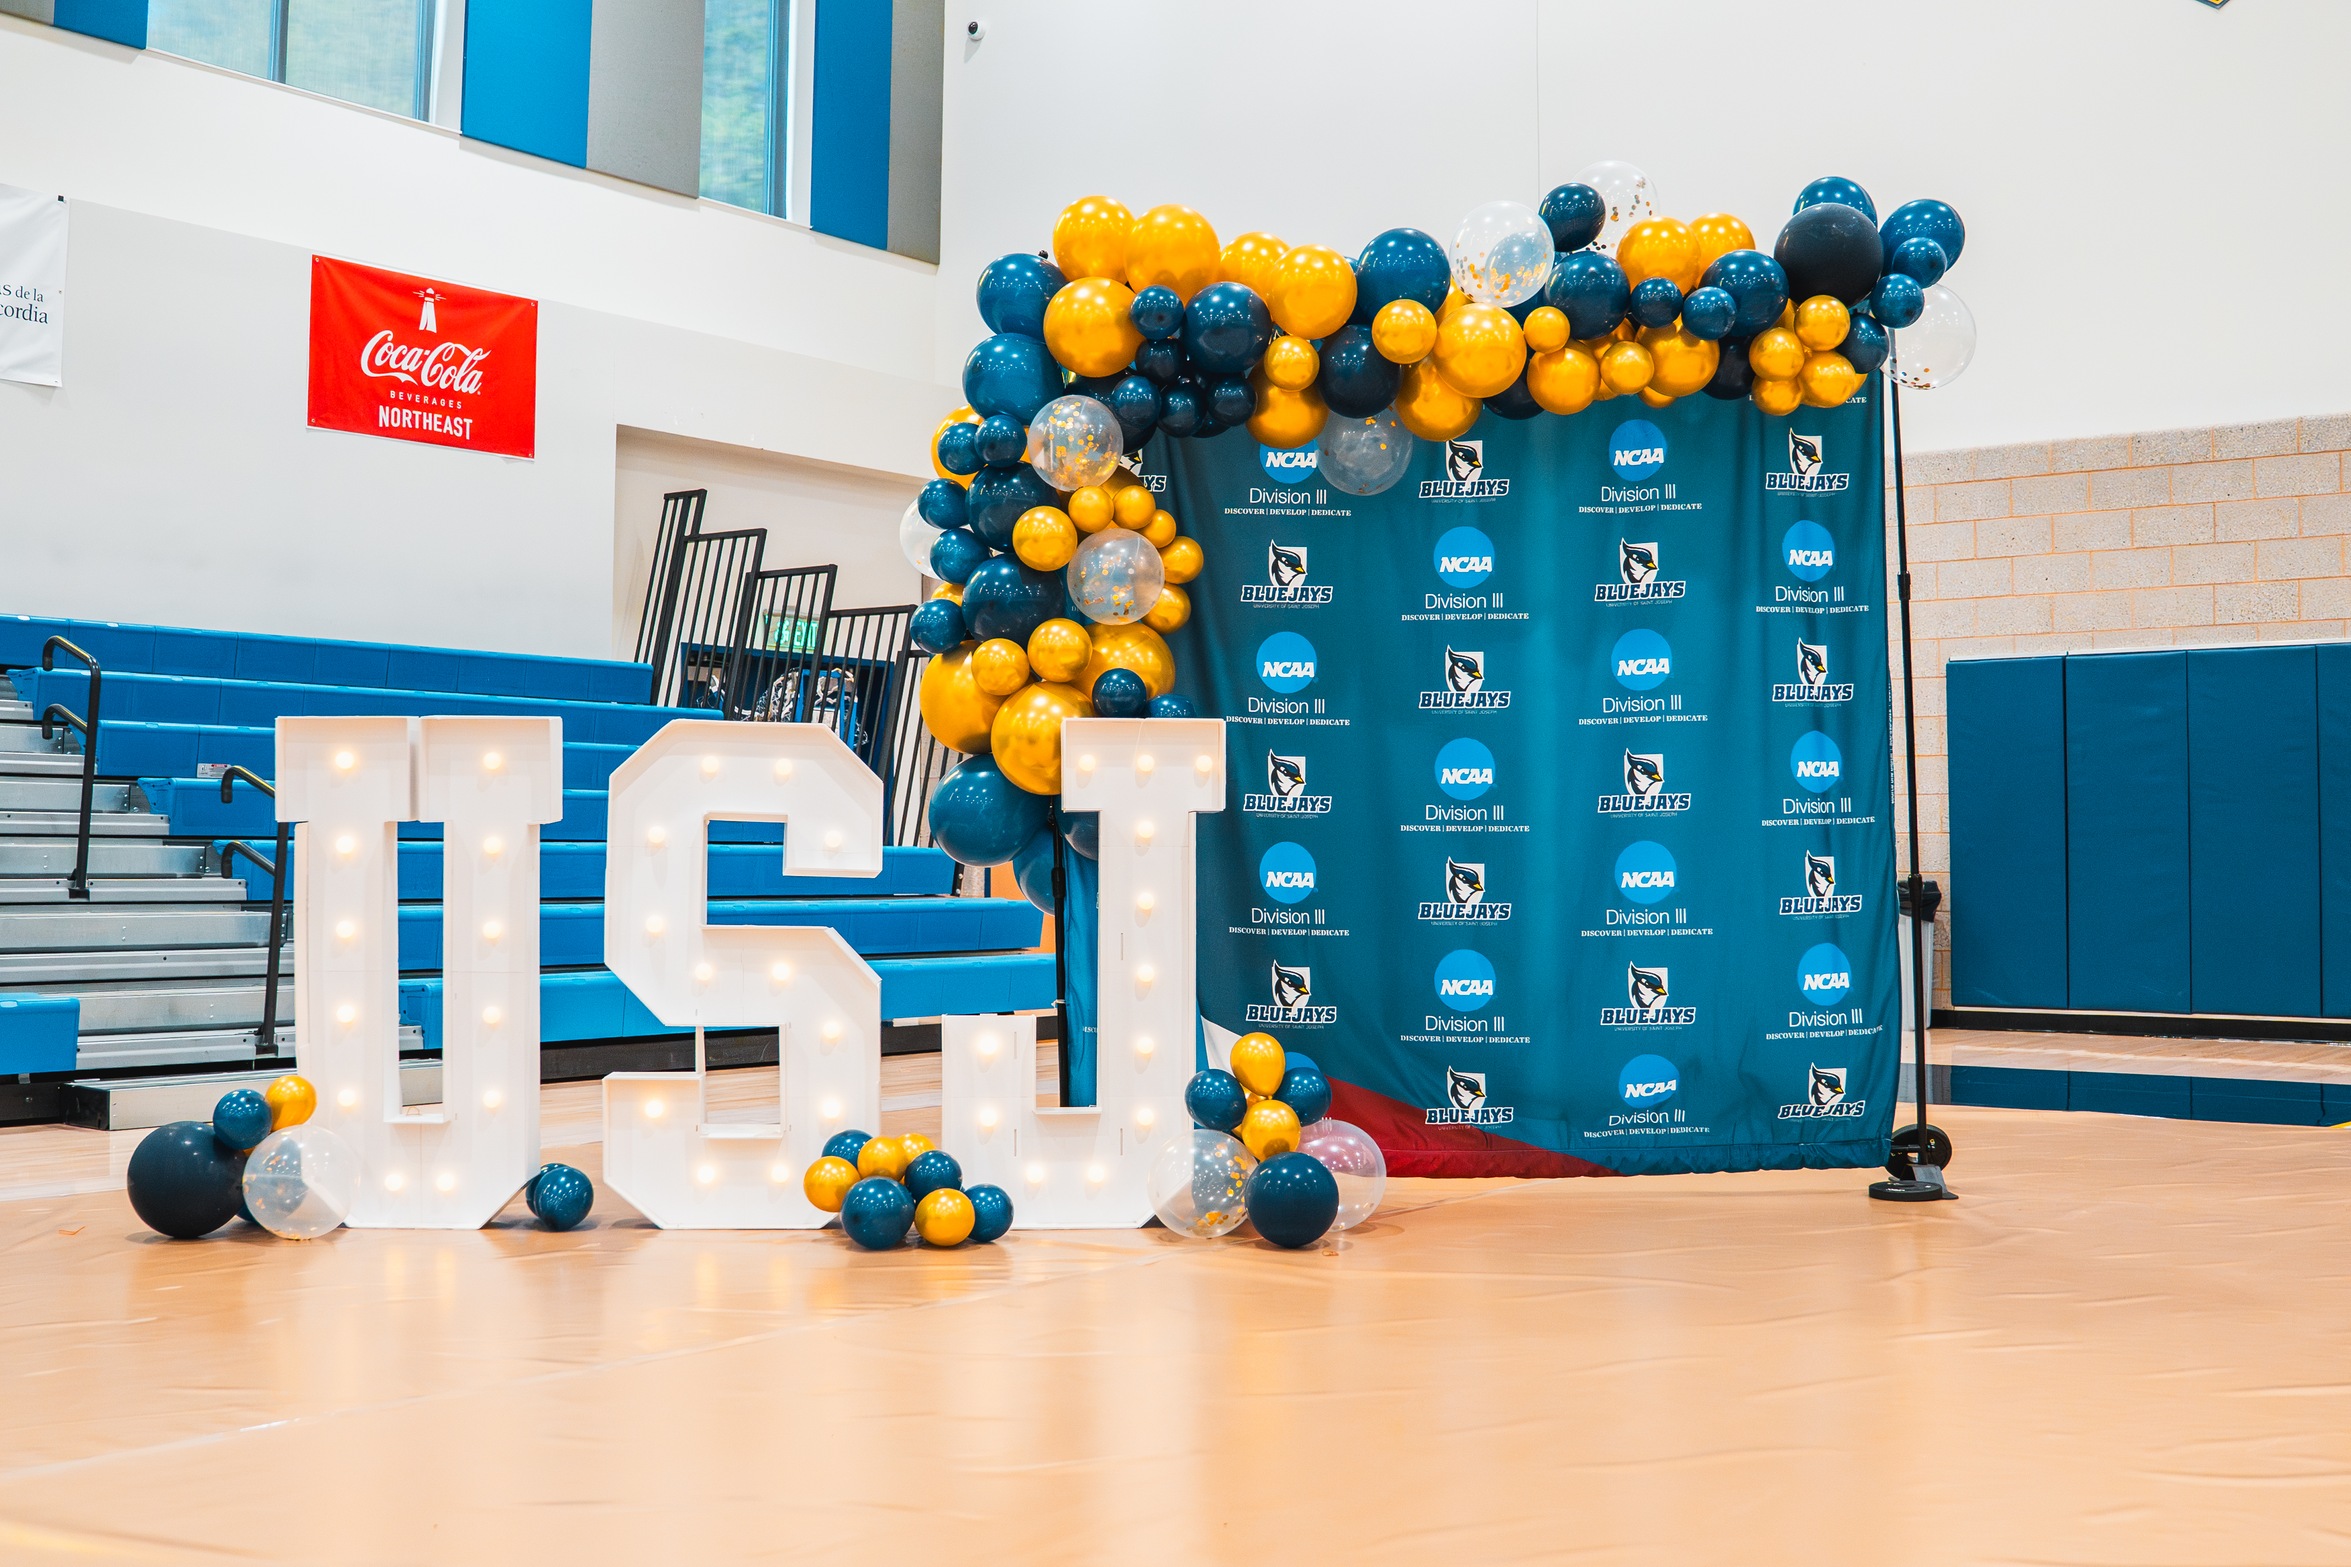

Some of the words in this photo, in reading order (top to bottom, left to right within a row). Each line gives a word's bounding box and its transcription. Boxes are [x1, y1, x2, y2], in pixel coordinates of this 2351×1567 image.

[15, 285, 31, 299] de
[33, 288, 44, 303] la
[360, 330, 491, 394] Coca-Cola
[390, 390, 462, 409] BEVERAGES
[379, 405, 473, 440] NORTHEAST
[1265, 451, 1318, 469] NCAA
[1613, 447, 1665, 467] NCAA
[1418, 479, 1510, 498] BLUEJAYS
[1765, 472, 1849, 491] BLUEJAYS
[1249, 487, 1311, 505] Division
[1315, 488, 1328, 505] III
[1601, 485, 1660, 503] Division
[1664, 483, 1676, 500] III
[1224, 507, 1266, 516] DISCOVER
[1269, 508, 1307, 516] DEVELOP
[1311, 509, 1352, 517] DEDICATE
[1578, 506, 1615, 514] DISCOVER
[1618, 505, 1657, 514] DEVELOP
[1660, 502, 1703, 511] DEDICATE
[1439, 556, 1493, 573] NCAA
[1788, 549, 1833, 567] NCAA
[1240, 585, 1333, 603] BLUEJAYS
[1594, 580, 1686, 601] BLUEJAYS
[1775, 585, 1829, 603] Division
[1833, 585, 1845, 602] III
[1425, 593, 1487, 610] Division
[1492, 592, 1504, 609] III
[1755, 605, 1791, 613] DISCOVER
[1795, 606, 1825, 614] DEVELOP
[1829, 605, 1870, 614] DEDICATE
[1401, 613, 1441, 621] DISCOVER
[1444, 613, 1483, 621] DEVELOP
[1487, 612, 1530, 620] DEDICATE
[1262, 661, 1315, 678] NCAA
[1616, 657, 1670, 677] NCAA
[1418, 691, 1511, 709] BLUEJAYS
[1772, 684, 1854, 702] BLUEJAYS
[1248, 696, 1309, 714] Division
[1314, 698, 1325, 714] III
[1602, 695, 1665, 714] Division
[1670, 694, 1682, 711] III
[1226, 716, 1263, 725] DISCOVER
[1267, 717, 1305, 726] DEVELOP
[1309, 718, 1351, 726] DEDICATE
[1578, 717, 1619, 726] DISCOVER
[1623, 715, 1662, 724] DEVELOP
[1665, 714, 1708, 722] DEDICATE
[1440, 767, 1494, 785] NCAA
[1796, 760, 1840, 778] NCAA
[1243, 794, 1332, 813] BLUEJAYS
[1597, 792, 1691, 813] BLUEJAYS
[1782, 797, 1835, 815] Division
[1840, 797, 1852, 813] III
[1425, 804, 1488, 821] Division
[1493, 804, 1504, 821] III
[1761, 818, 1800, 827] DISCOVER
[1803, 818, 1832, 826] DEVELOP
[1836, 816, 1876, 825] DEDICATE
[1400, 824, 1442, 832] DISCOVER
[1487, 825, 1530, 833] DEDICATE
[1265, 871, 1315, 889] NCAA
[1620, 871, 1675, 889] NCAA
[1417, 902, 1512, 920] BLUEJAYS
[1779, 894, 1862, 915] BLUEJAYS
[1251, 907, 1310, 925] Division
[1314, 908, 1325, 925] III
[1606, 908, 1670, 925] Division
[1675, 907, 1687, 924] III
[1228, 926, 1267, 935] DISCOVER
[1271, 928, 1308, 936] DEVELOP
[1310, 929, 1350, 937] DEDICATE
[1581, 929, 1623, 937] DISCOVER
[1626, 929, 1666, 937] DEVELOP
[1670, 928, 1714, 936] DEDICATE
[1440, 979, 1494, 996] NCAA
[1803, 972, 1850, 991] NCAA
[1245, 1004, 1337, 1023] BLUEJAYS
[1600, 1007, 1696, 1025] BLUEJAYS
[1788, 1010, 1848, 1028] Division
[1851, 1008, 1863, 1024] III
[1425, 1015, 1488, 1032] Division
[1493, 1016, 1505, 1032] III
[1400, 1034, 1442, 1043] DISCOVER
[1445, 1035, 1484, 1043] DEVELOP
[1488, 1036, 1531, 1044] DEDICATE
[1765, 1031, 1805, 1040] DISCOVER
[1809, 1029, 1845, 1038] DEVELOP
[1624, 1079, 1677, 1099] NCAA
[1424, 1106, 1513, 1125] BLUEJAYS
[1608, 1109, 1669, 1127] Division
[1674, 1108, 1686, 1123] III
[1777, 1100, 1865, 1119] BLUEJAYS
[1583, 1130, 1625, 1139] DISCOVER
[1628, 1127, 1667, 1135] DEVELOP
[1669, 1126, 1710, 1134] DEDICATE
